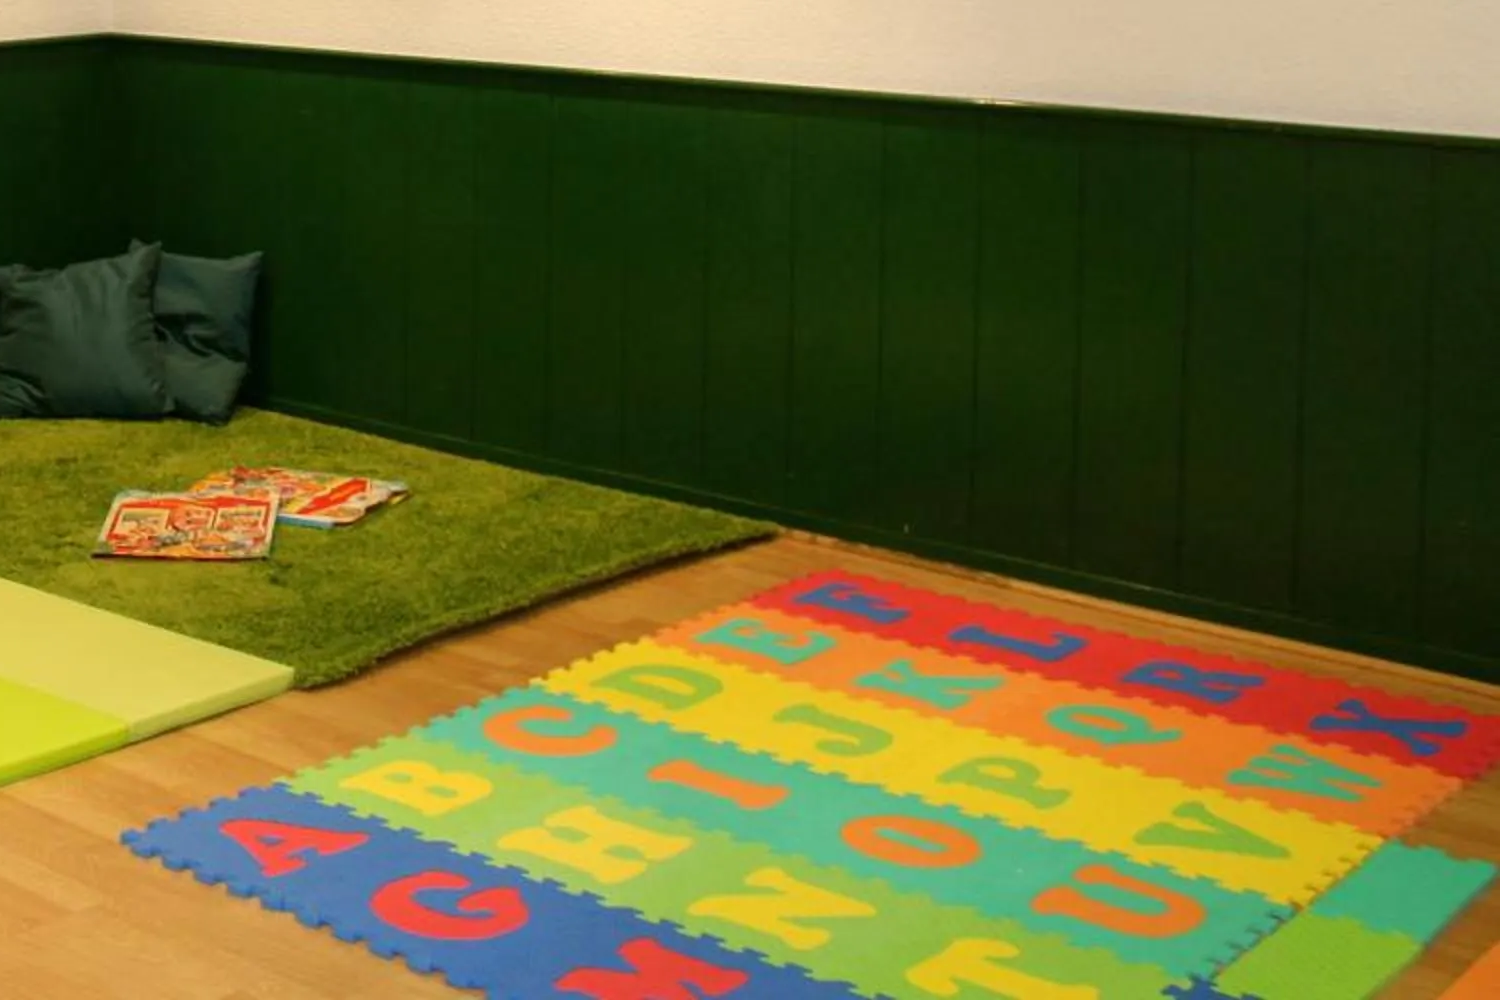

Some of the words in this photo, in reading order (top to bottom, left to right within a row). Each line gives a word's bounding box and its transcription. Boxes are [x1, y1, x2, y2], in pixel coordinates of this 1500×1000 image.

[221, 819, 366, 875] A
[342, 760, 490, 814] B
[485, 706, 615, 755] C
[592, 665, 721, 709] D
[695, 618, 834, 663] E
[795, 583, 907, 623] F
[372, 870, 527, 938] G
[500, 806, 691, 883] H
[648, 761, 788, 808] I
[774, 704, 892, 755] J
[857, 659, 1004, 709] K
[950, 626, 1086, 661] L
[689, 867, 875, 950] N
[842, 815, 981, 867] O
[938, 757, 1070, 808] P
[1045, 705, 1181, 745] Q
[1121, 661, 1264, 703] R
[1032, 865, 1204, 937] U
[1134, 802, 1288, 858] V
[1226, 744, 1384, 801] W
[1310, 700, 1466, 755] X
